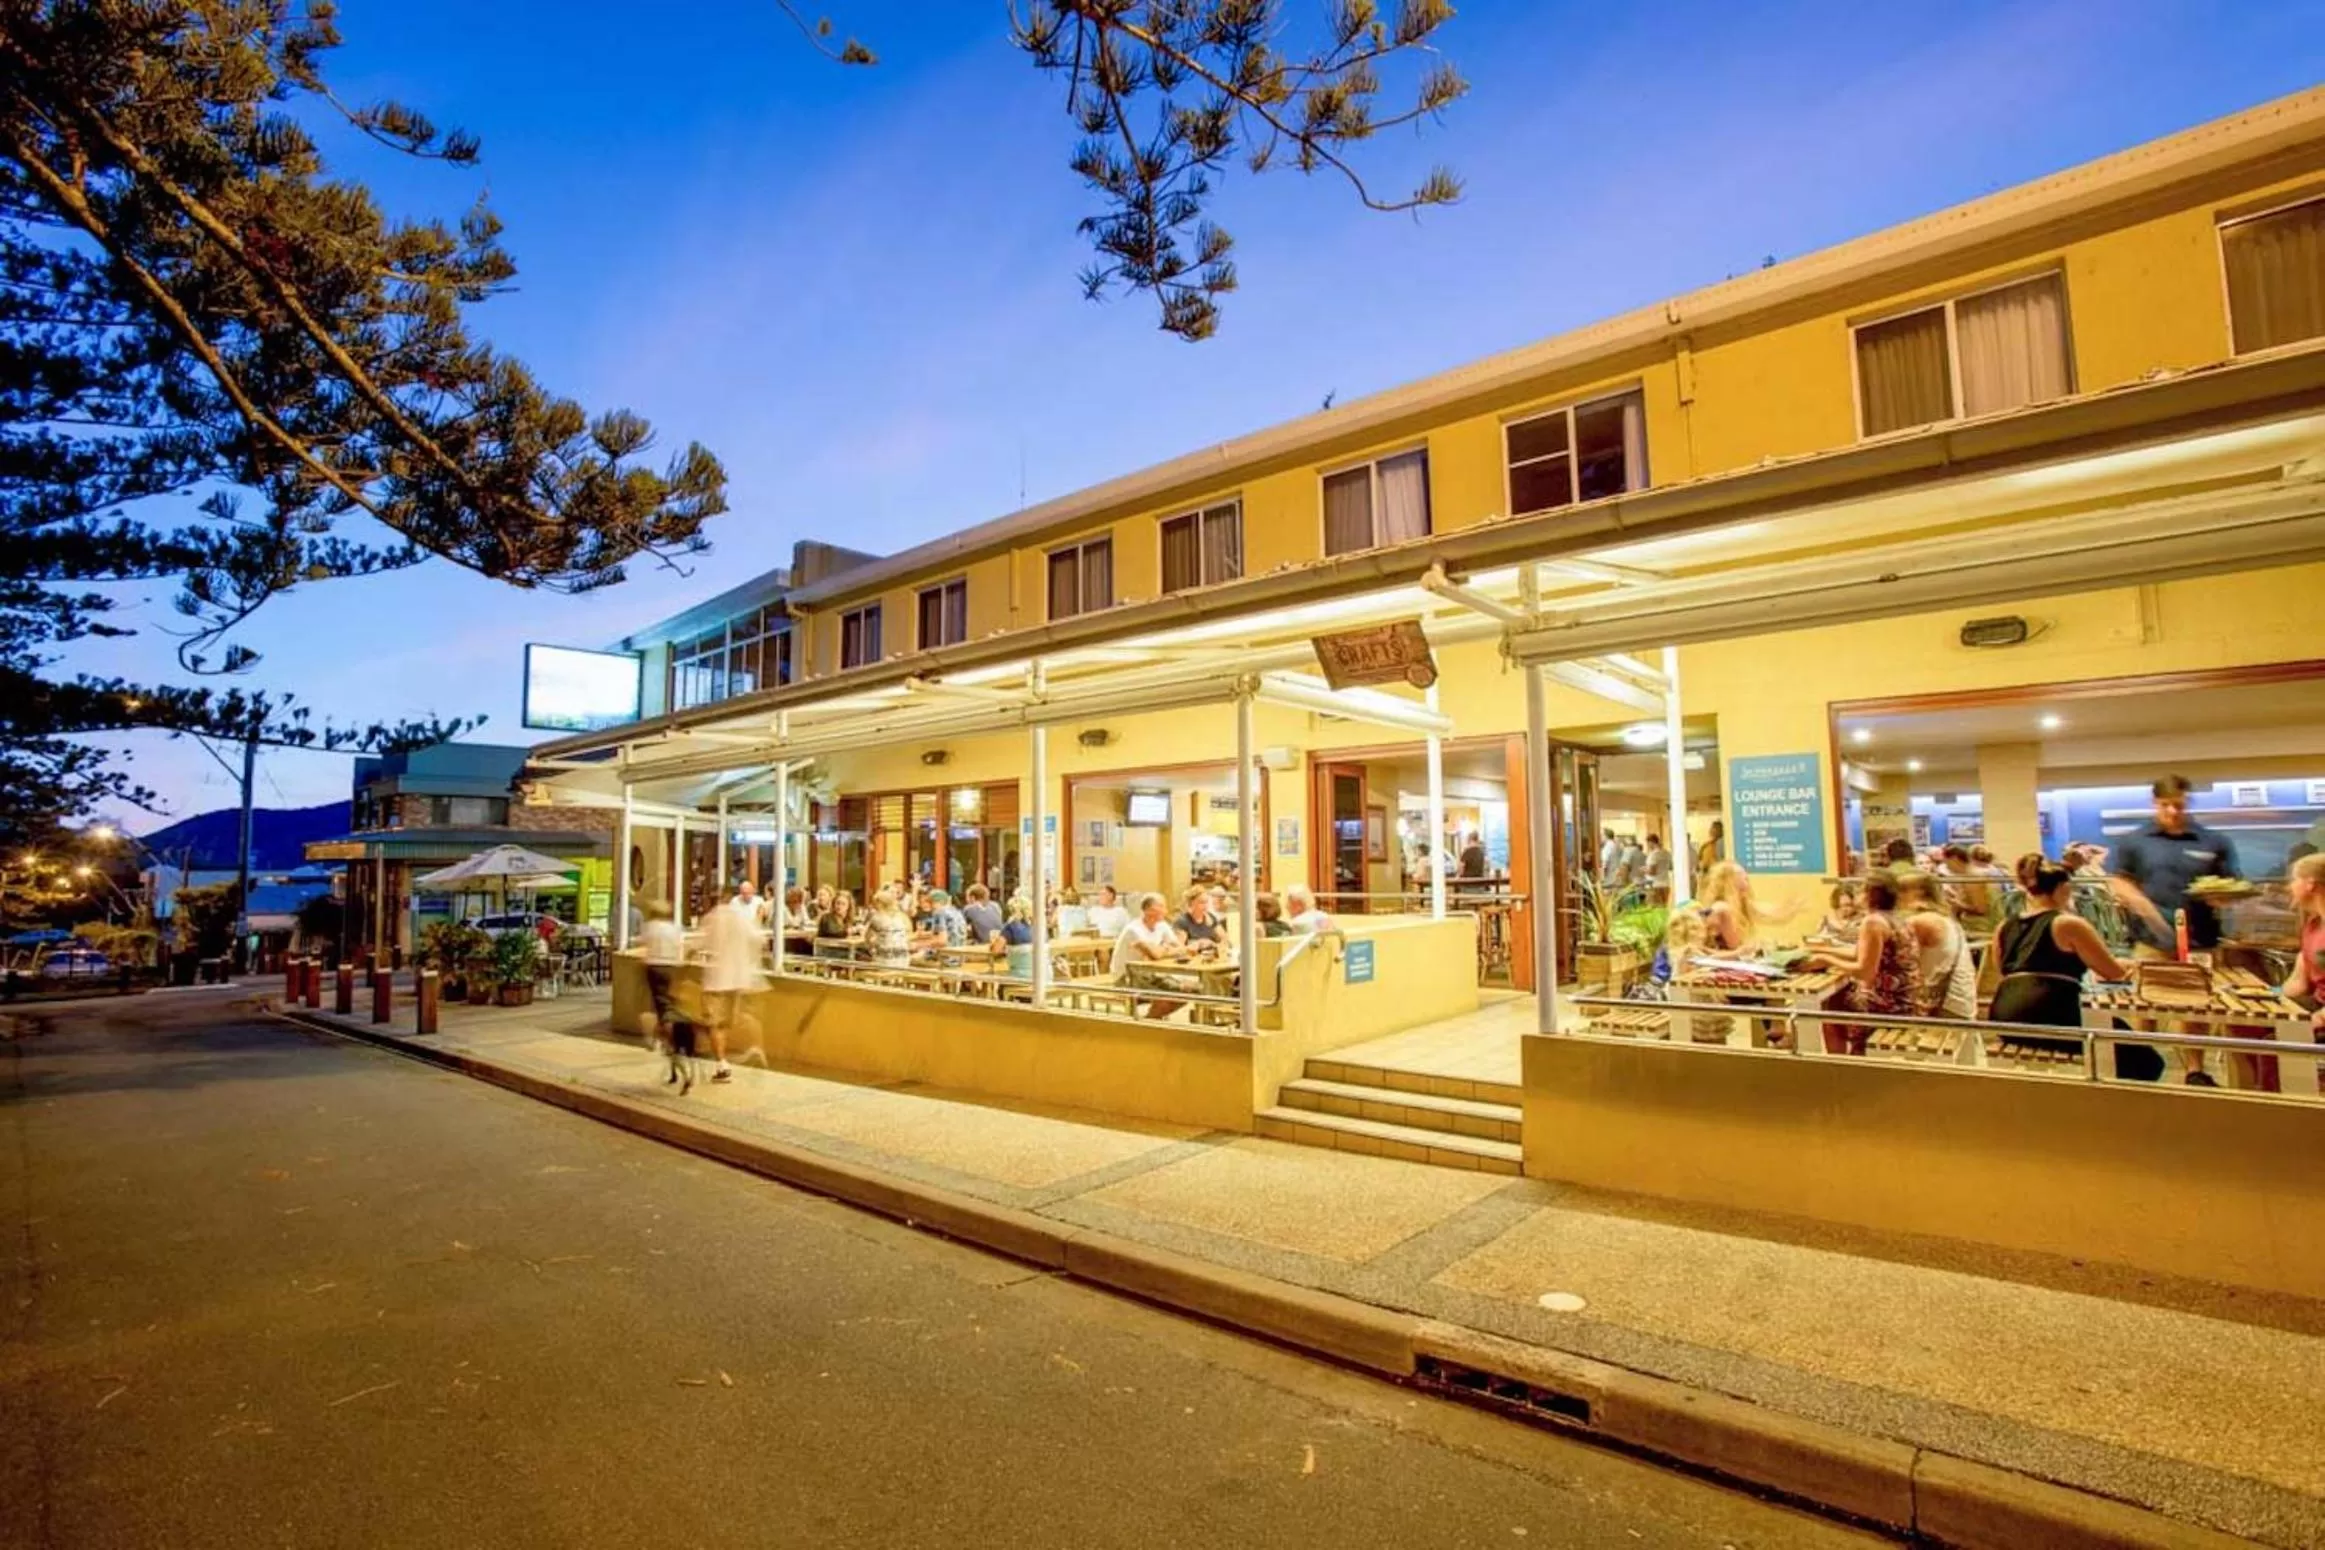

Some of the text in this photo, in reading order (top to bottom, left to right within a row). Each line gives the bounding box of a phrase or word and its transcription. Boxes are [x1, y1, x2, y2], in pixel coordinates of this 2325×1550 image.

[1735, 786, 1817, 802] LOUNGE BAR
[1742, 802, 1810, 817] ENTRANCE
